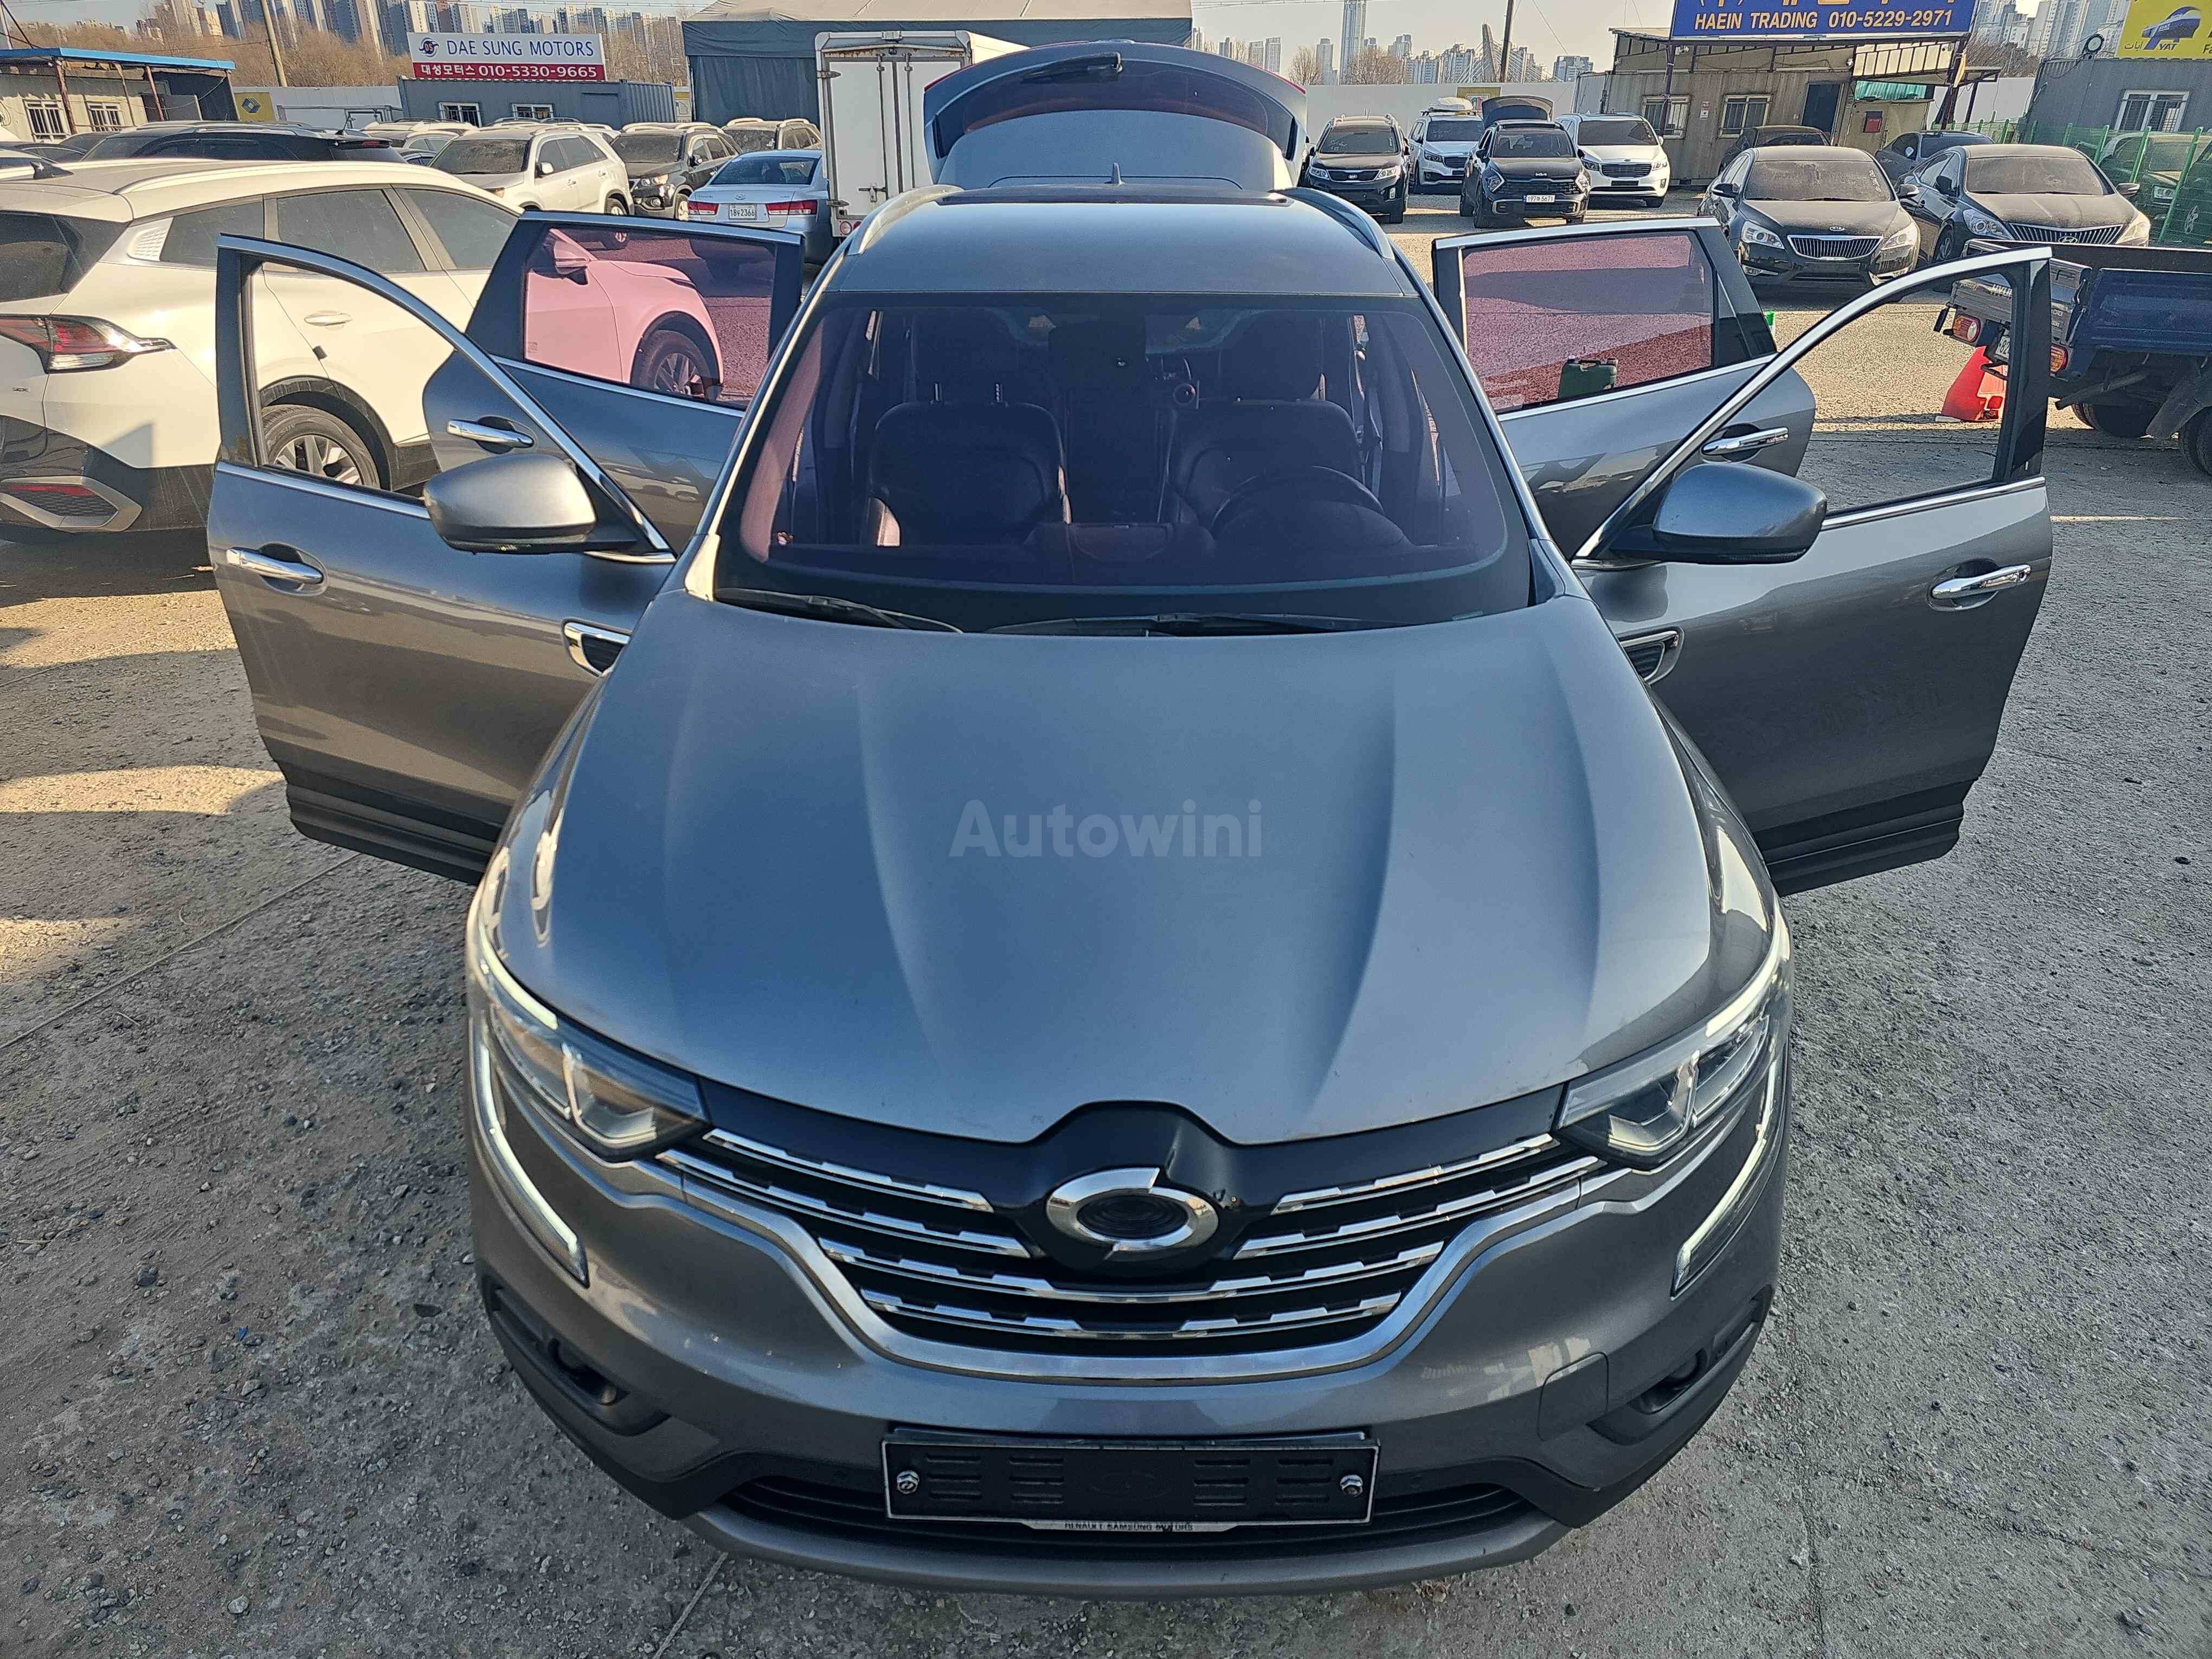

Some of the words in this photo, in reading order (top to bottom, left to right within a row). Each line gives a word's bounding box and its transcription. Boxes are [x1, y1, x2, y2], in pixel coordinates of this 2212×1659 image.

[1695, 13, 1742, 30] HAEIN
[1750, 11, 1817, 28] TRADING
[1828, 10, 1952, 27] 010-5229-2971
[447, 40, 477, 55] DAE
[483, 41, 522, 55] SUNG
[530, 41, 594, 56] MOTORS
[421, 65, 475, 75] 대성모터스
[479, 66, 596, 77] 010-5330-9665
